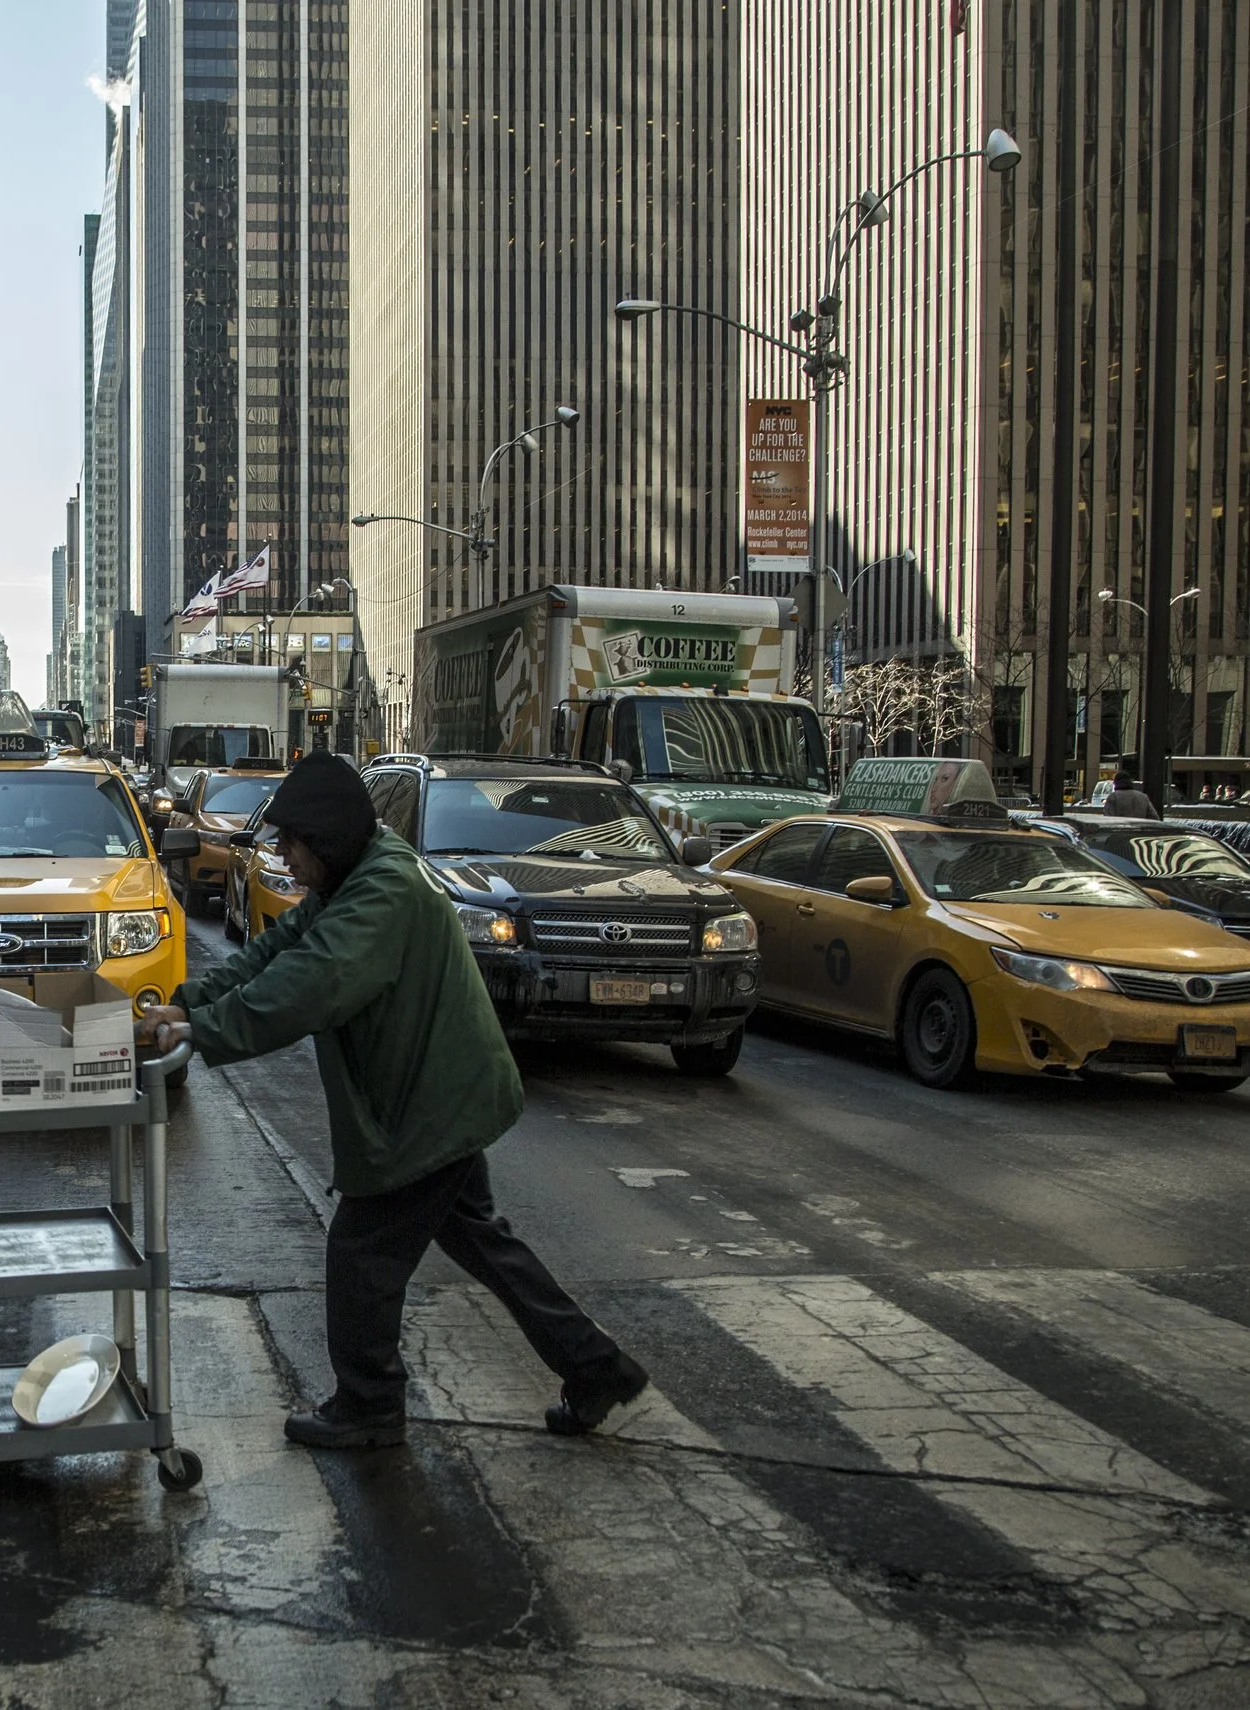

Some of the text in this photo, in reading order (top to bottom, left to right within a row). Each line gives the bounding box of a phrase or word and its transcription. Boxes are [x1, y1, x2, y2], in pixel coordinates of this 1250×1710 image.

[759, 418, 797, 431] ARE YOU
[752, 434, 804, 447] UP FOR THE
[750, 449, 805, 462] CHALLENGE?
[752, 471, 776, 484] MS
[747, 510, 806, 522] MARCH 2,2014
[748, 527, 807, 537] Rockefeller Center
[671, 604, 685, 616] 12
[637, 636, 736, 662] COFFEE
[636, 659, 735, 672] DISTRIBUTING CORP.
[850, 762, 935, 784] FLASHDANCERS
[844, 783, 925, 799] GENTLEMEN'S CLUB
[848, 799, 866, 809] 52ND
[873, 800, 911, 810] BROADWAY
[963, 804, 990, 817] 2H21
